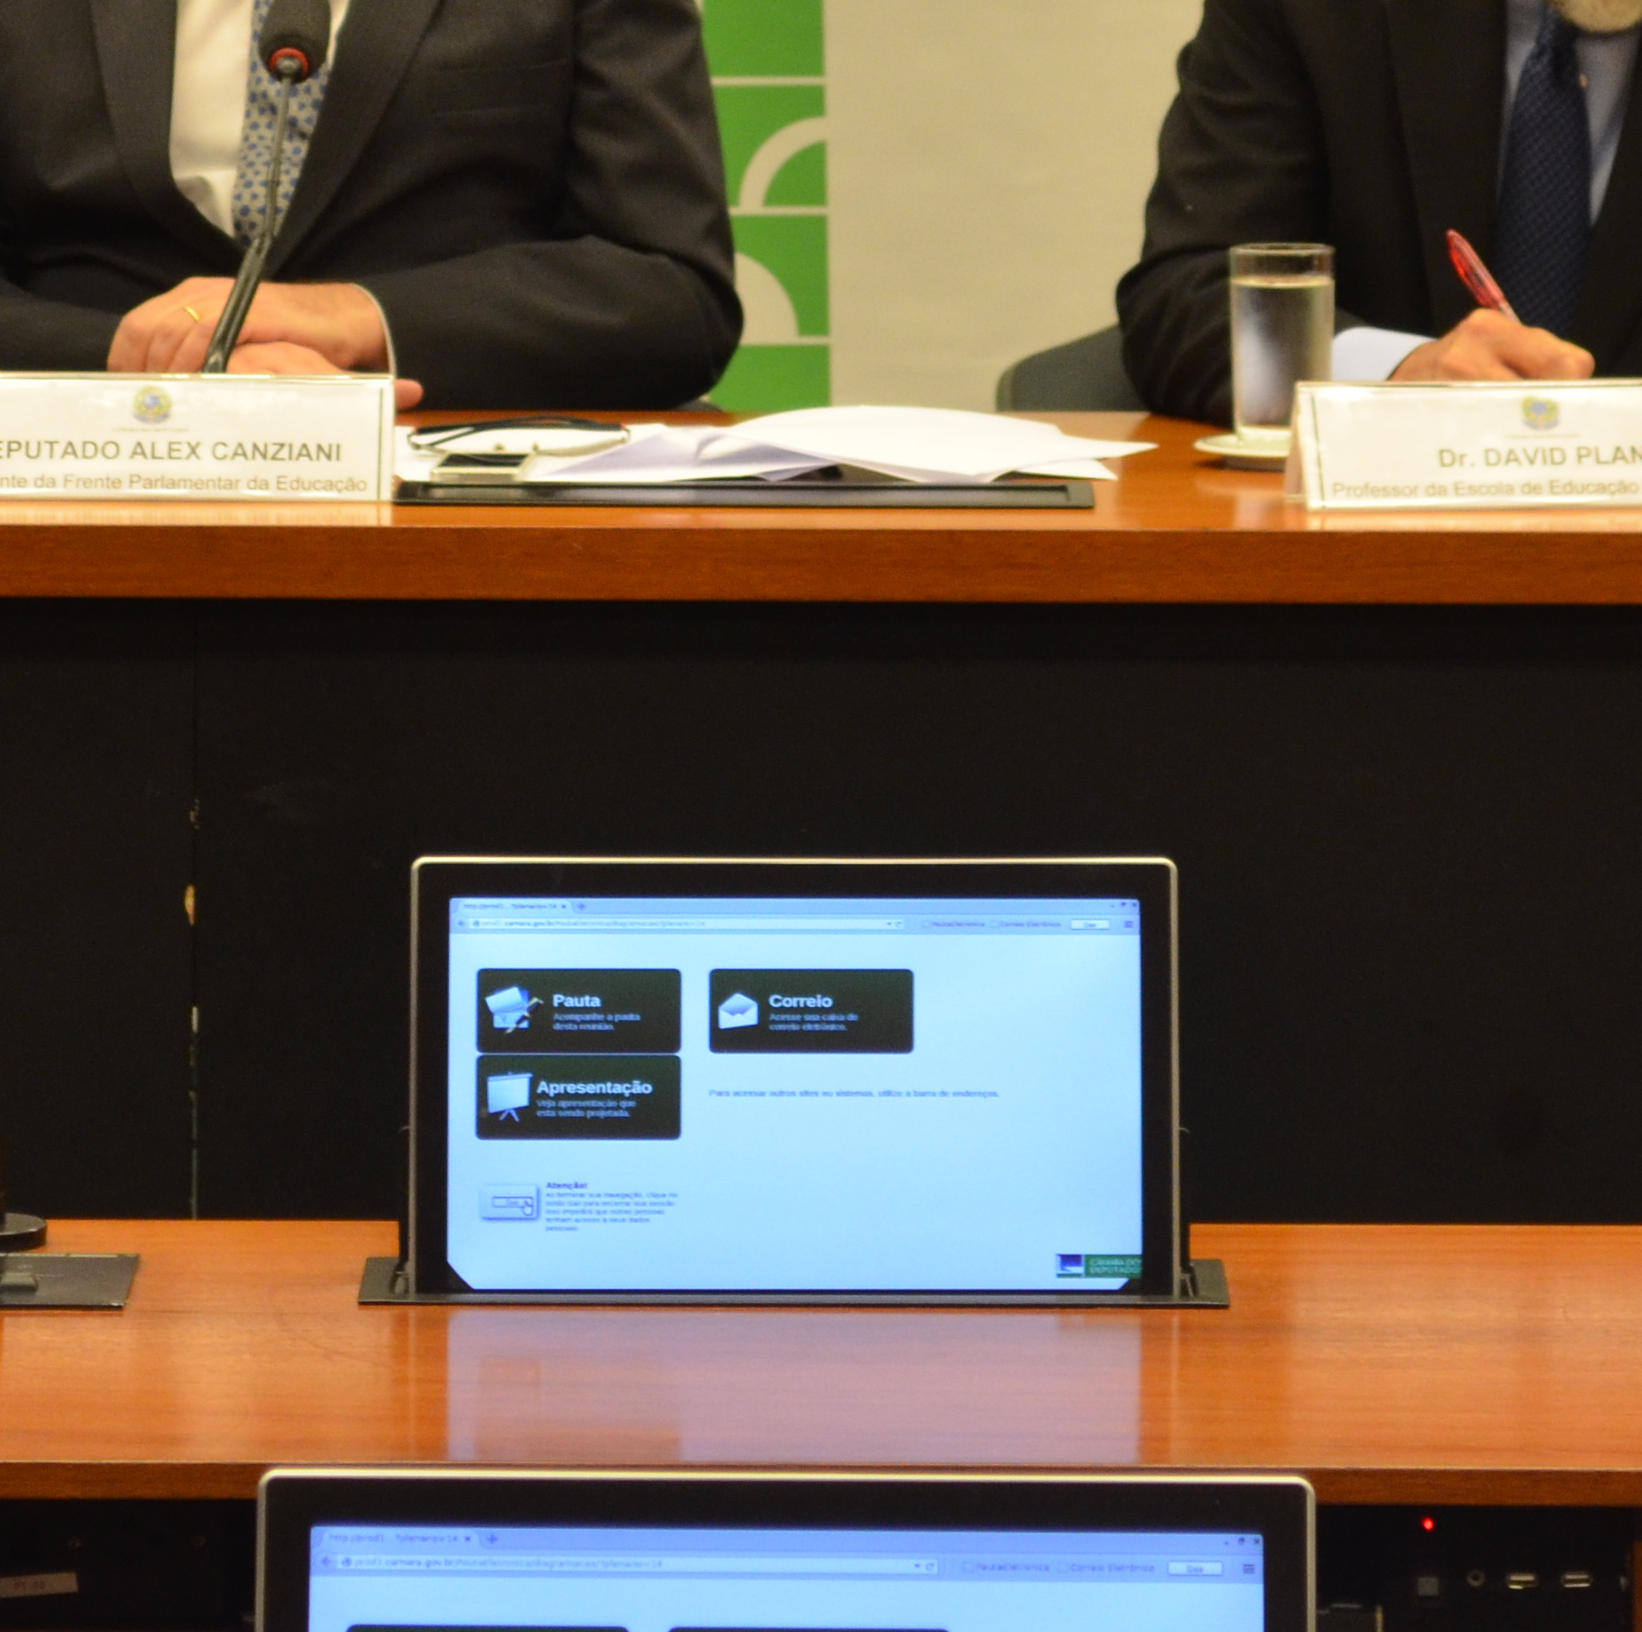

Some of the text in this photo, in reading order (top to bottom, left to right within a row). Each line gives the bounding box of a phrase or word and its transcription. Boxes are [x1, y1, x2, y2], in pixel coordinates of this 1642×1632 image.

[129, 441, 202, 461] ALEX
[212, 441, 342, 462] CANZIANI
[1438, 448, 1476, 468] Dr.
[1484, 446, 1567, 467] DAVID
[34, 473, 57, 489] da
[63, 473, 122, 489] Frente
[128, 474, 241, 491] Parlamentar
[246, 475, 269, 491] da
[276, 475, 368, 494] Educação
[1332, 481, 1419, 498] Professor
[1425, 481, 1448, 497] da
[1453, 481, 1515, 497] Escola
[1520, 480, 1544, 496] de
[1548, 478, 1639, 496] Educação
[552, 993, 602, 1008] Pauta
[768, 994, 834, 1008] Correio
[536, 1079, 654, 1098] Apresentação
